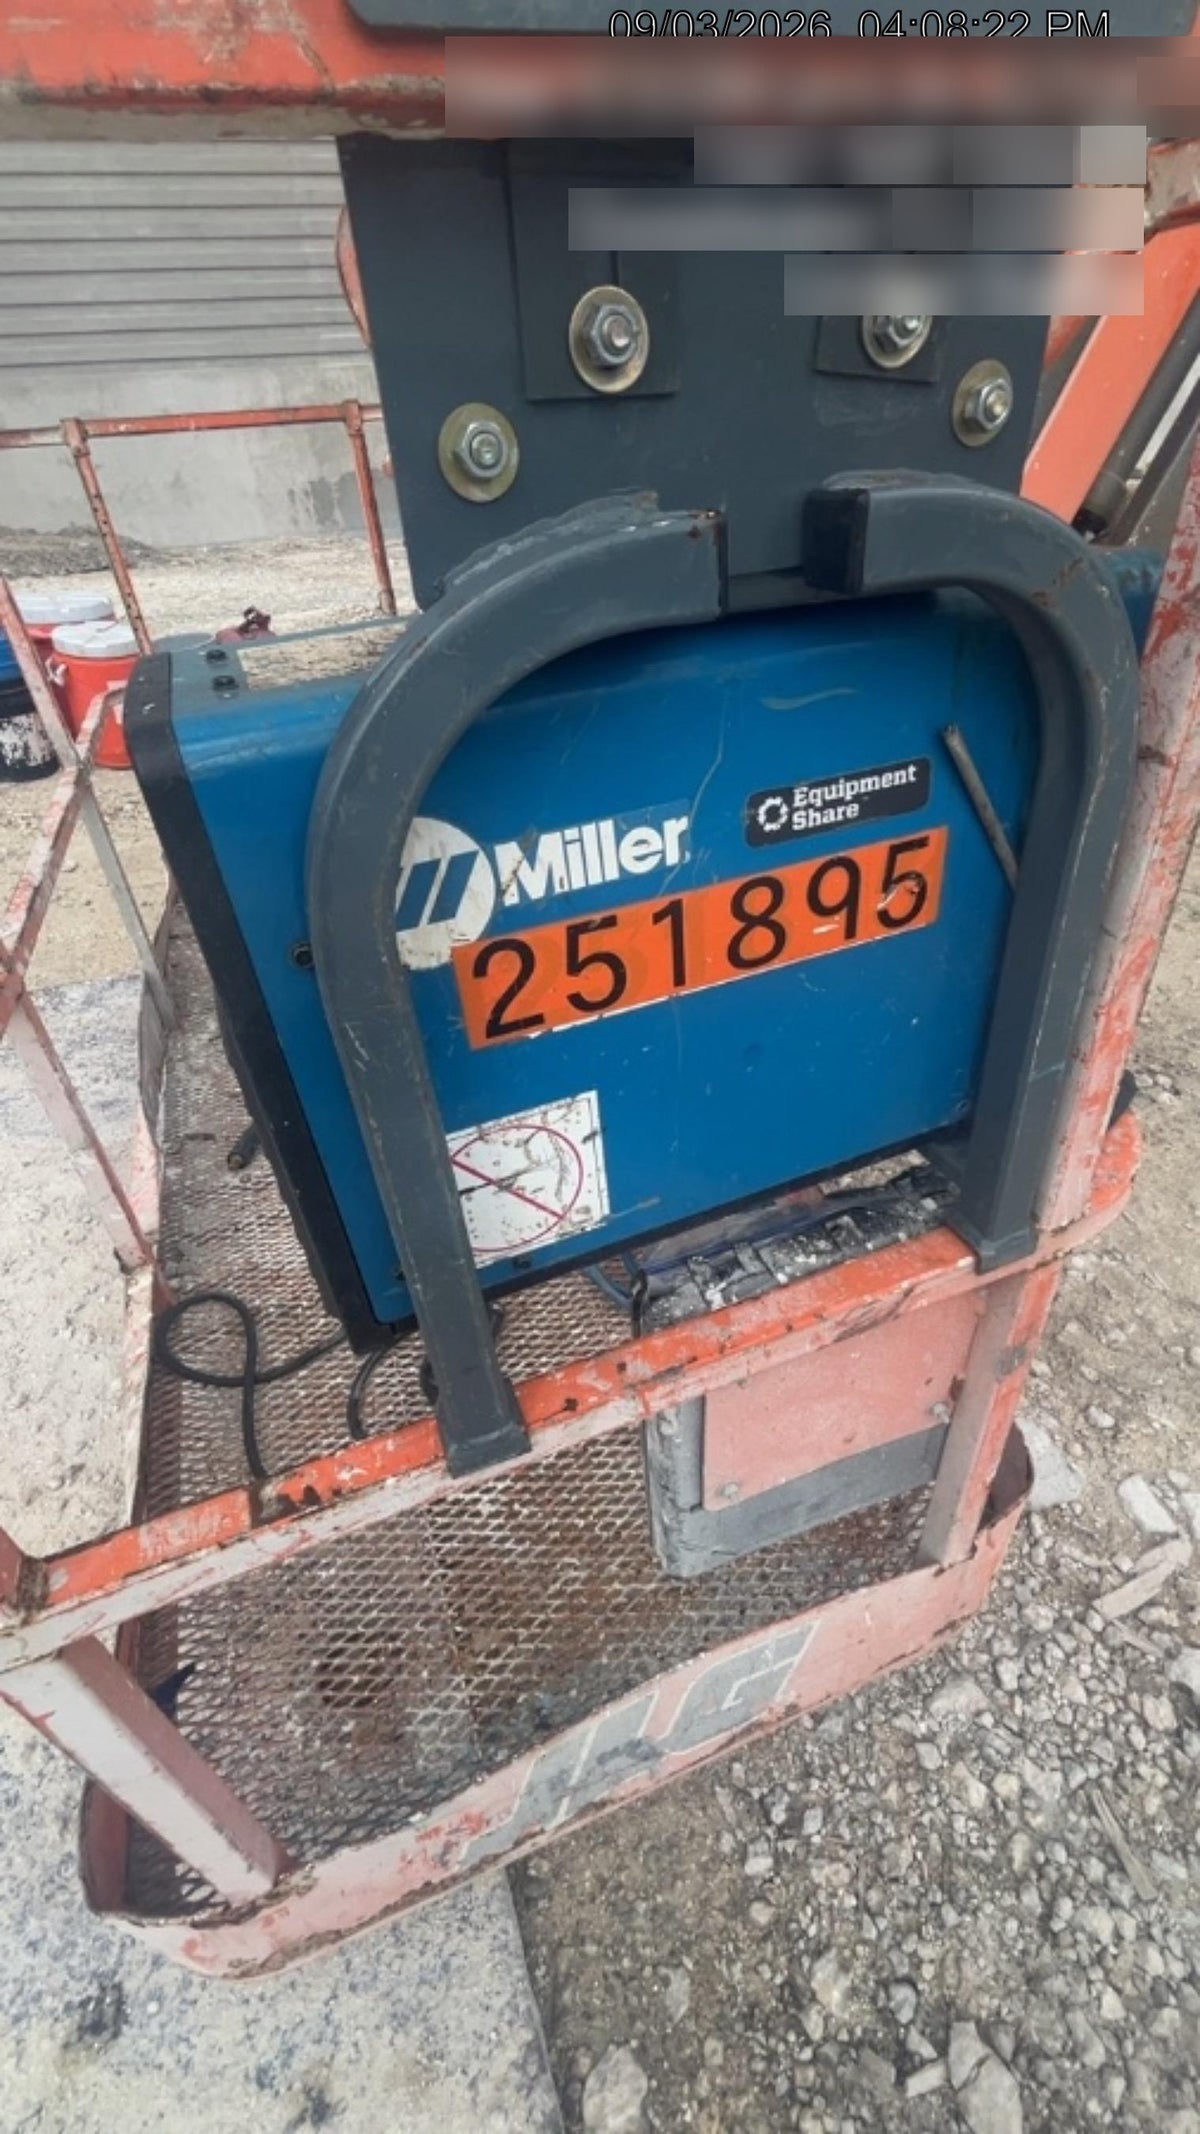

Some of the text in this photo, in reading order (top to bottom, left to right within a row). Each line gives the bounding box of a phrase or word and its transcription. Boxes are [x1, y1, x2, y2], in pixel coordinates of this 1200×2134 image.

[791, 802, 860, 831] Share
[792, 764, 917, 808] Equipment
[494, 815, 689, 906] Miller
[472, 835, 930, 1040] 251895
